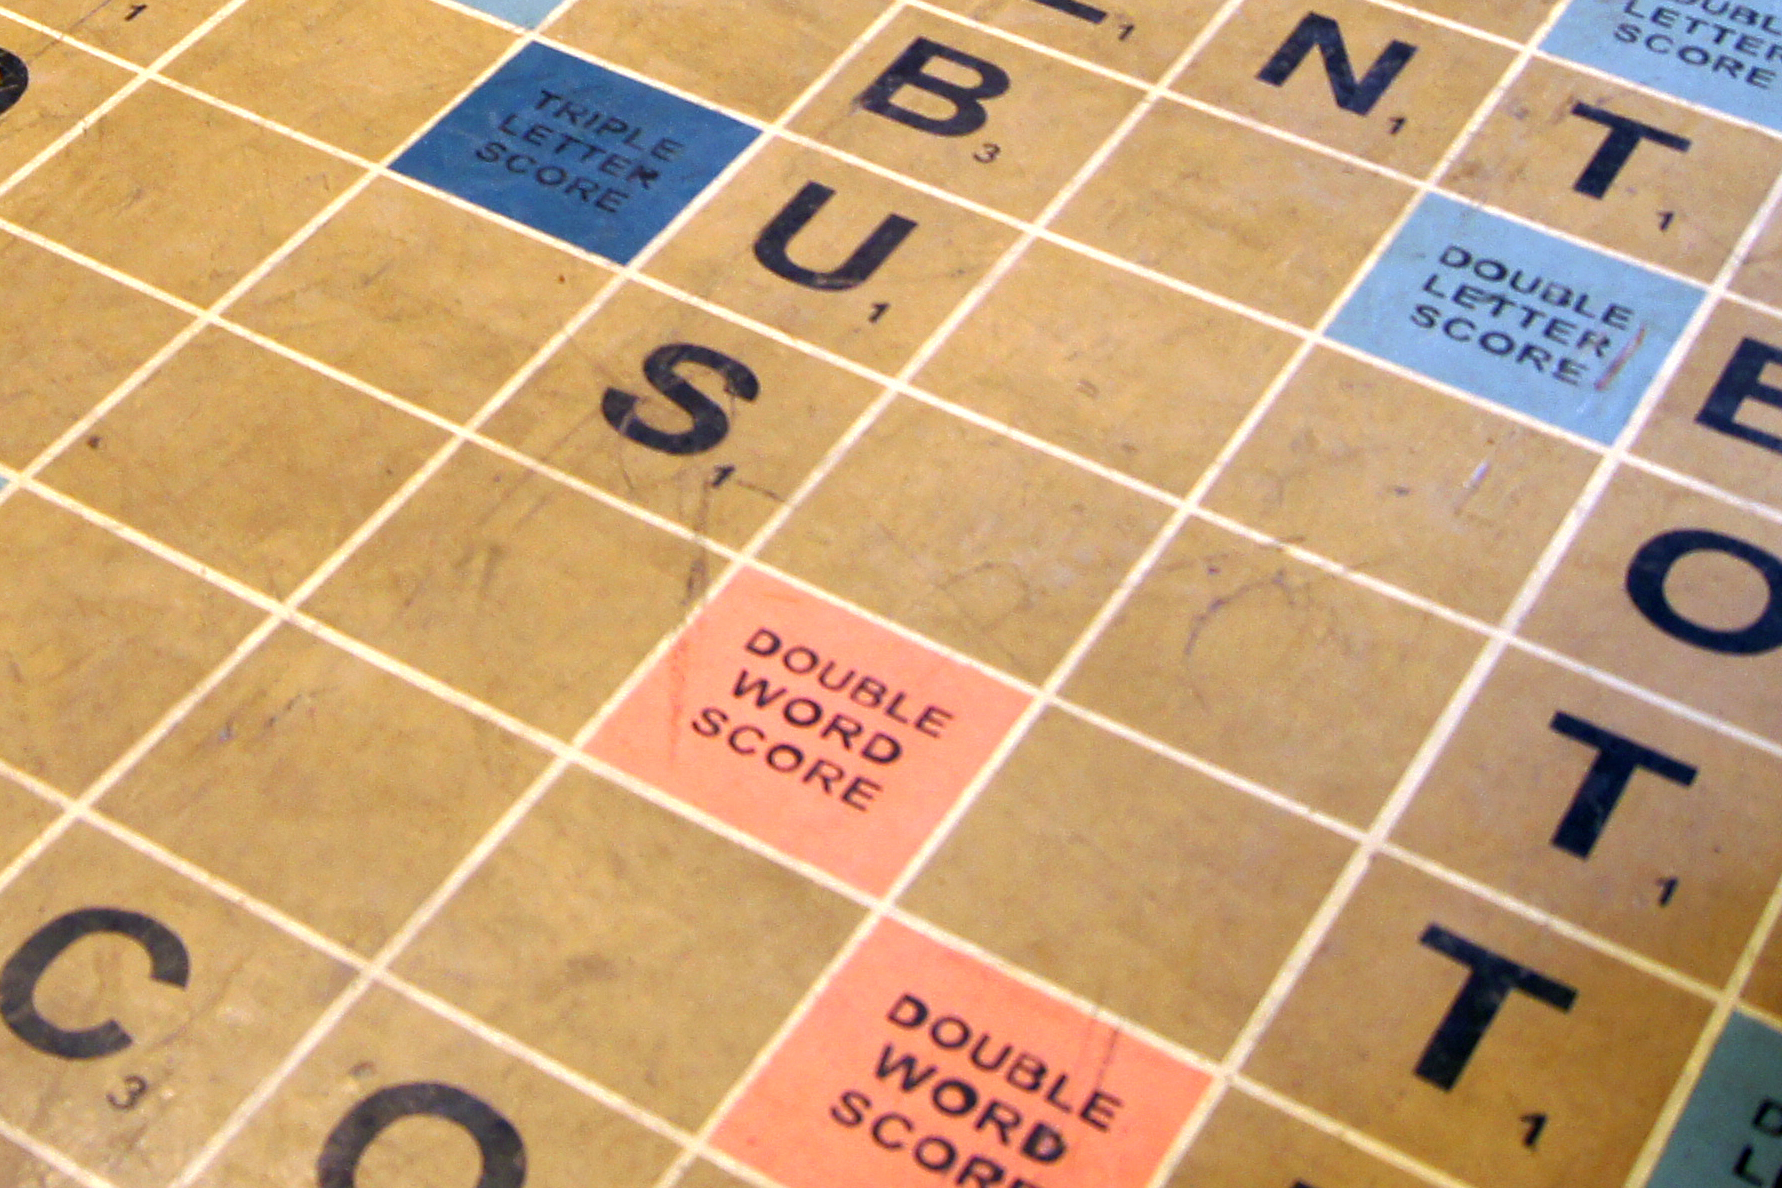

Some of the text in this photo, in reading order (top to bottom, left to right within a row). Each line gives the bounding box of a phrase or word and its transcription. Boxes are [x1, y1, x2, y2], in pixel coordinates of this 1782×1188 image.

[1612, 22, 1776, 89] SCORE
[495, 111, 662, 190] LETTER
[534, 88, 684, 163] TRIPLE
[472, 140, 630, 216] SCORE
[1421, 273, 1612, 359] LETTER
[1437, 245, 1633, 330] DOUBLE
[1409, 303, 1586, 386] SCORE
[1625, 528, 1781, 655] O
[731, 669, 905, 767] WORD
[743, 627, 953, 738] DOUBLE
[690, 707, 882, 812] SCORE
[873, 1045, 1070, 1166] WORD
[887, 993, 1121, 1132] DOUBLE
[829, 1089, 1052, 1187] SCOR
